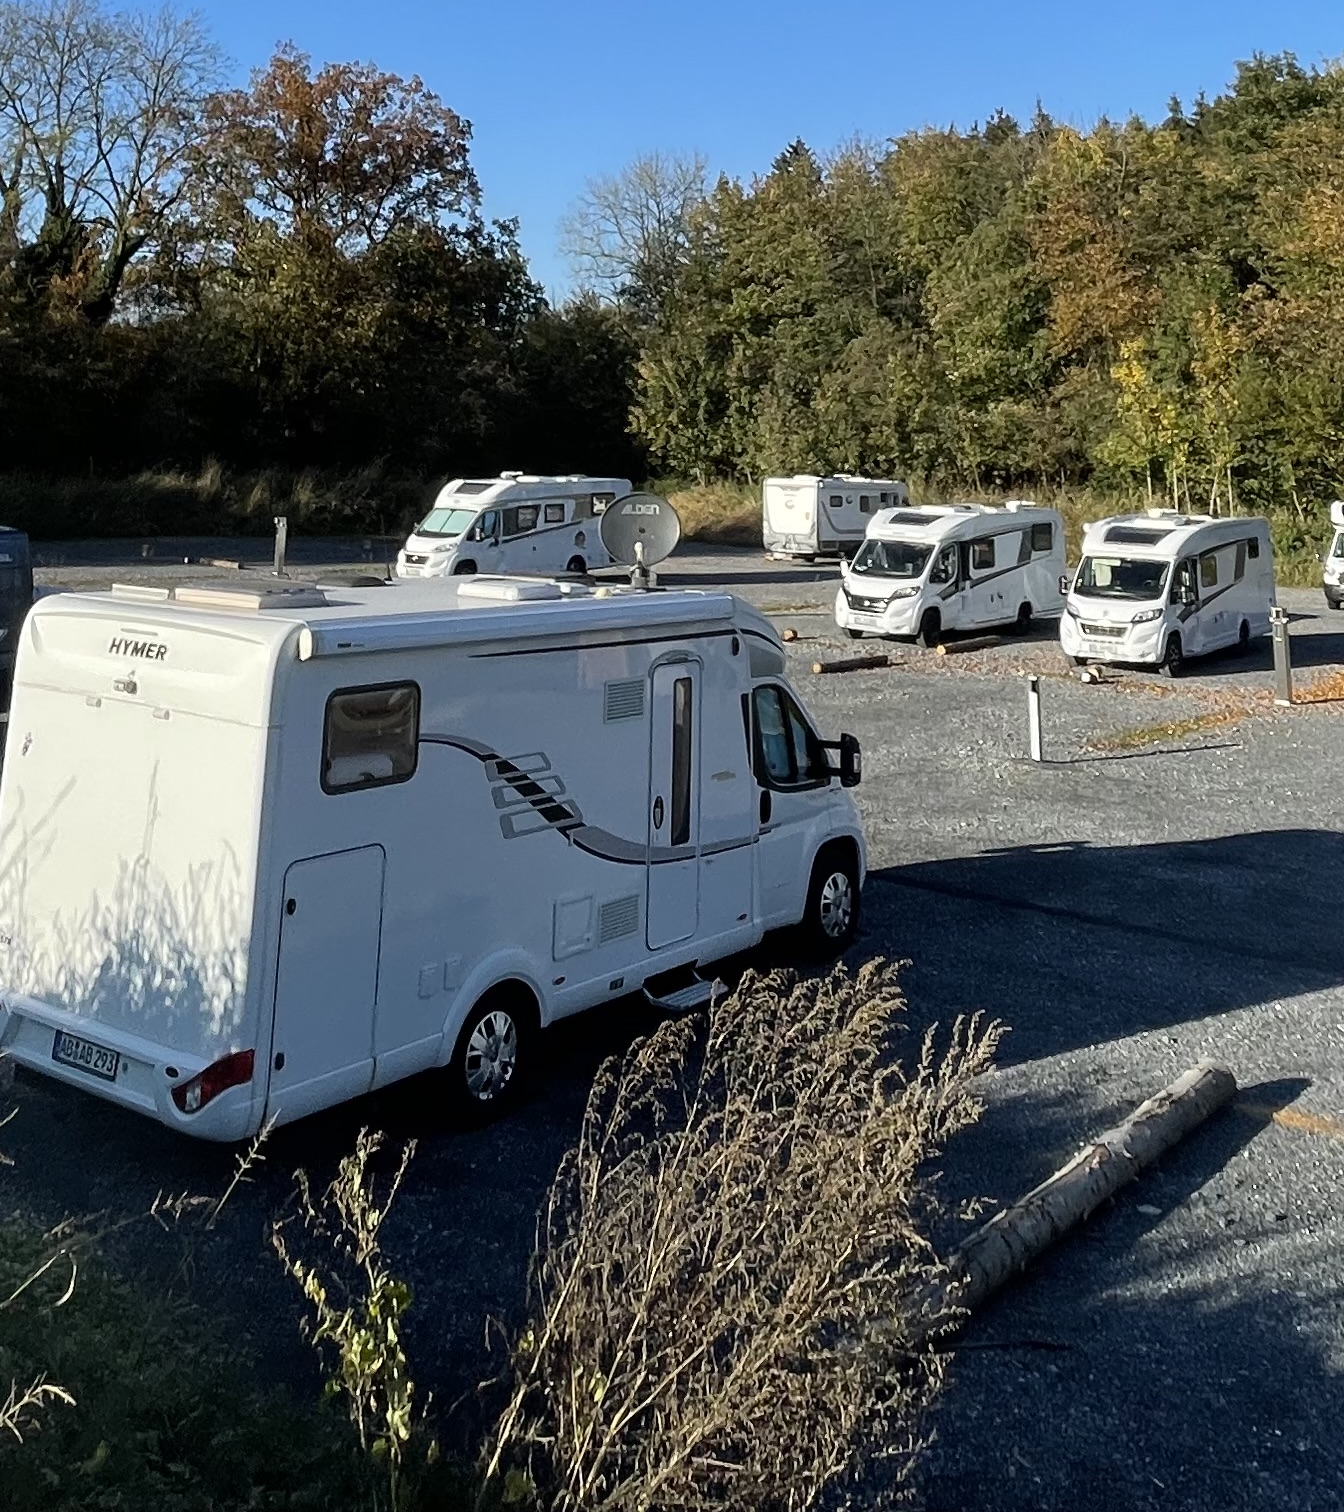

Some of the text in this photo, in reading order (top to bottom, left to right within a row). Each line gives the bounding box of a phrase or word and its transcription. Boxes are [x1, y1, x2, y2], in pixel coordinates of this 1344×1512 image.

[621, 503, 660, 515] ALDEN
[108, 637, 167, 661] HYMER
[94, 1050, 115, 1072] 293
